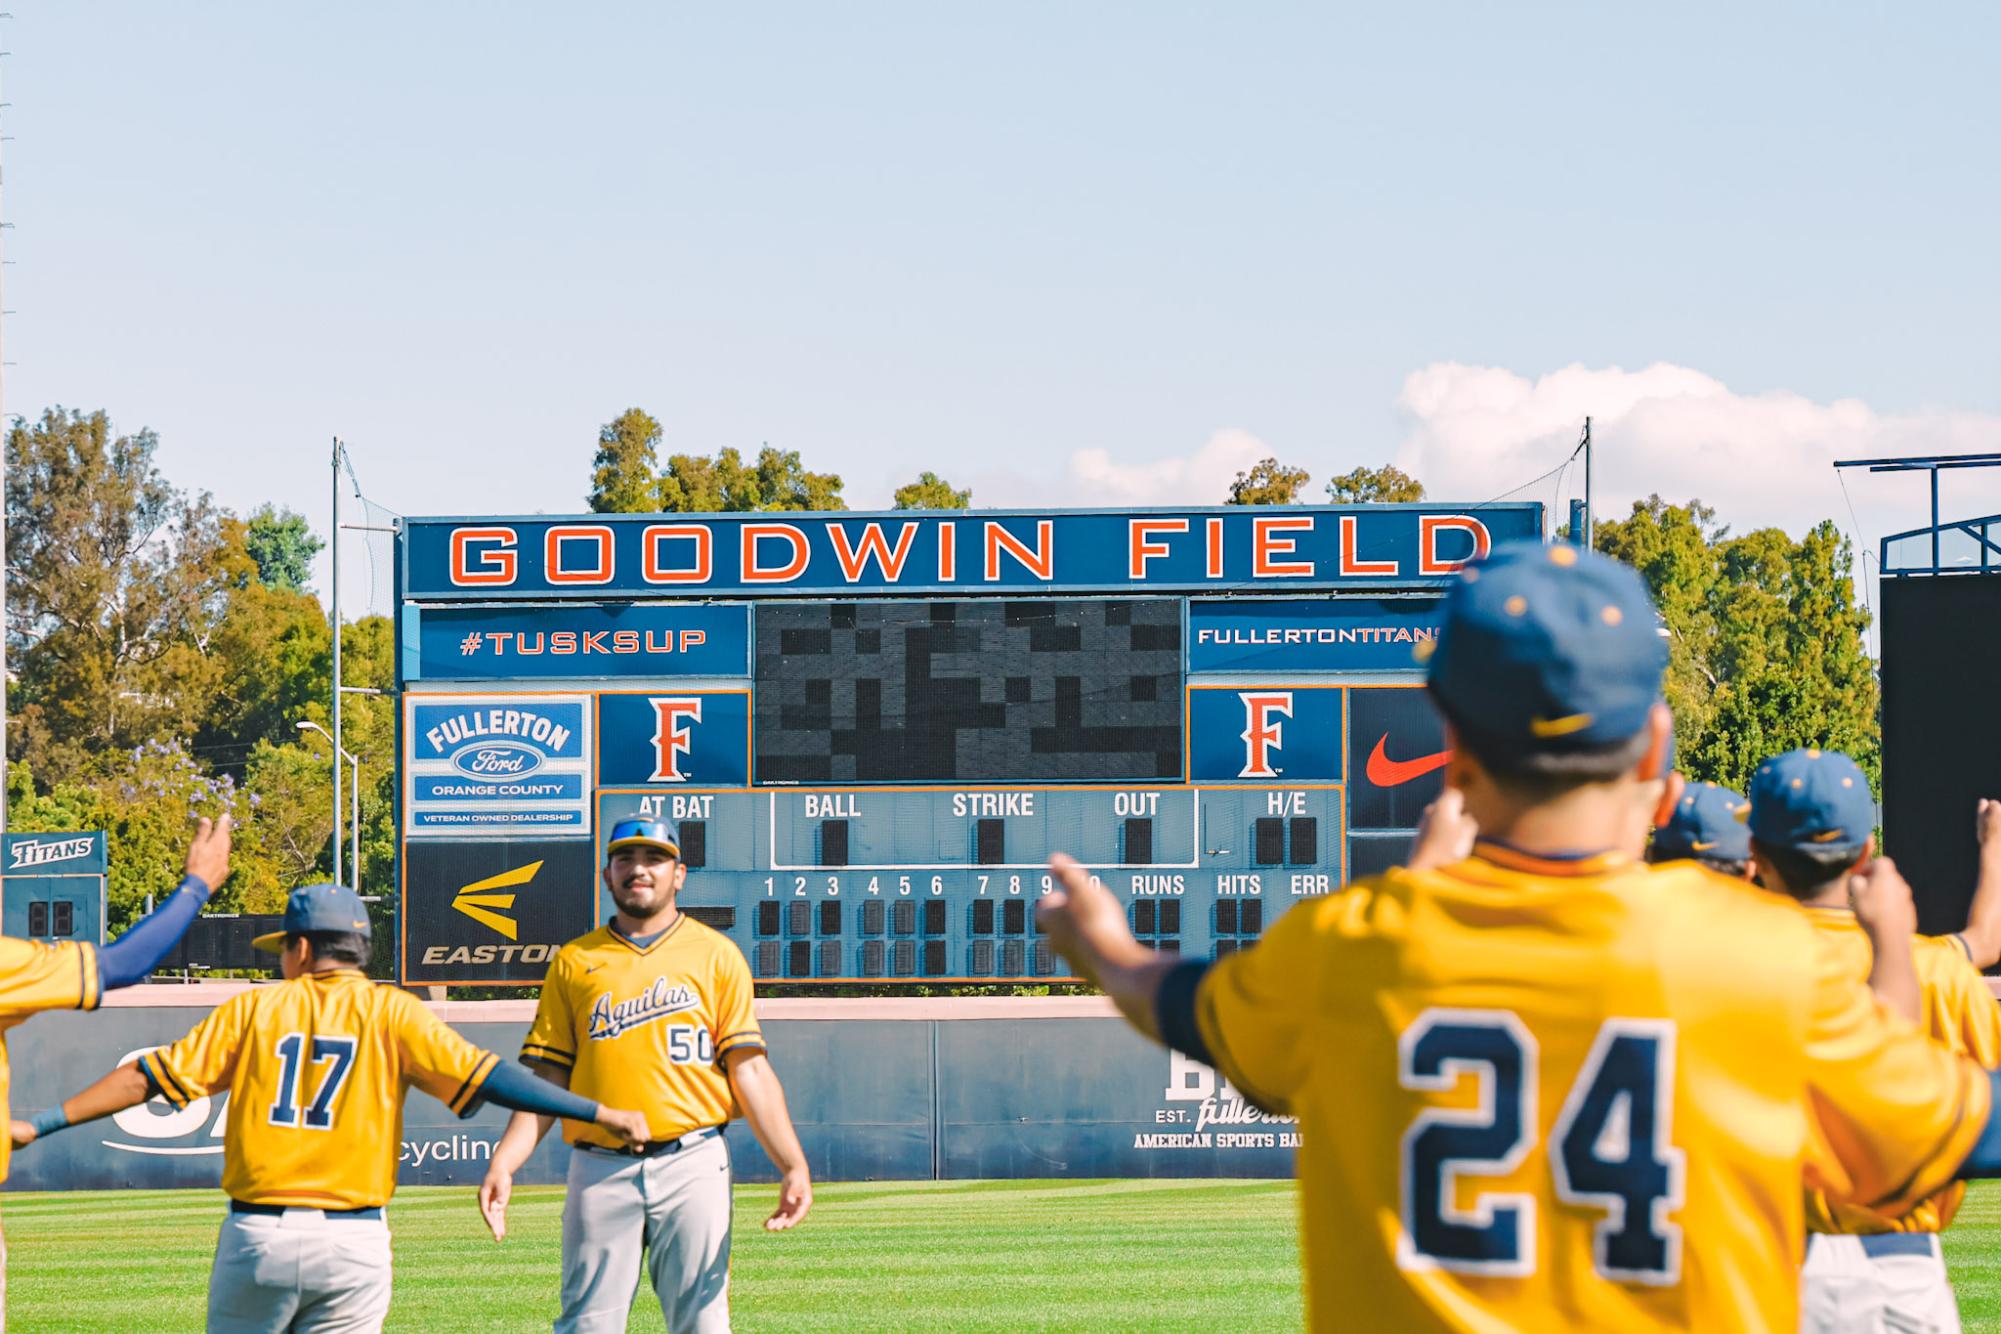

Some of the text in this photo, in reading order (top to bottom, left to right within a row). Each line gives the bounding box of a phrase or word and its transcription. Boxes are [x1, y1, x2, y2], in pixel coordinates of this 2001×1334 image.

[449, 514, 1492, 585] GOODWIN FIELD
[460, 629, 707, 657] #TUSKSUP
[426, 710, 571, 753] FULLERTON
[647, 697, 702, 781] F
[1237, 692, 1293, 777] F
[471, 749, 525, 772] Ford
[432, 784, 564, 796] ORANGE COUNTY
[640, 796, 715, 819] AT BAT
[805, 794, 862, 818] BALL
[952, 793, 1034, 817] STRIKE
[1114, 792, 1160, 816] OUT
[1267, 792, 1306, 817] H/E
[471, 814, 509, 822] OWNED
[11, 838, 92, 867] TITANS
[764, 877, 774, 896] 1
[795, 877, 806, 896] 2
[827, 876, 839, 896] 3
[868, 876, 879, 895] 4
[899, 876, 911, 895] 5
[931, 876, 943, 895] 6
[977, 876, 989, 895] 7
[1009, 876, 1021, 895] 8
[1041, 875, 1053, 895] 9
[1131, 875, 1185, 895] RUNS
[1217, 875, 1262, 895] HITS
[1291, 875, 1330, 894] ERR
[589, 976, 697, 1036] Aquilas
[668, 1024, 715, 1066] 50
[268, 1032, 358, 1130] 17
[1156, 1110, 1192, 1124] EST.
[398, 1134, 502, 1167] cyclin
[1134, 1133, 1213, 1149] AMERICAN
[1216, 1133, 1275, 1148] SPORTS
[1396, 1007, 1687, 1285] 24
